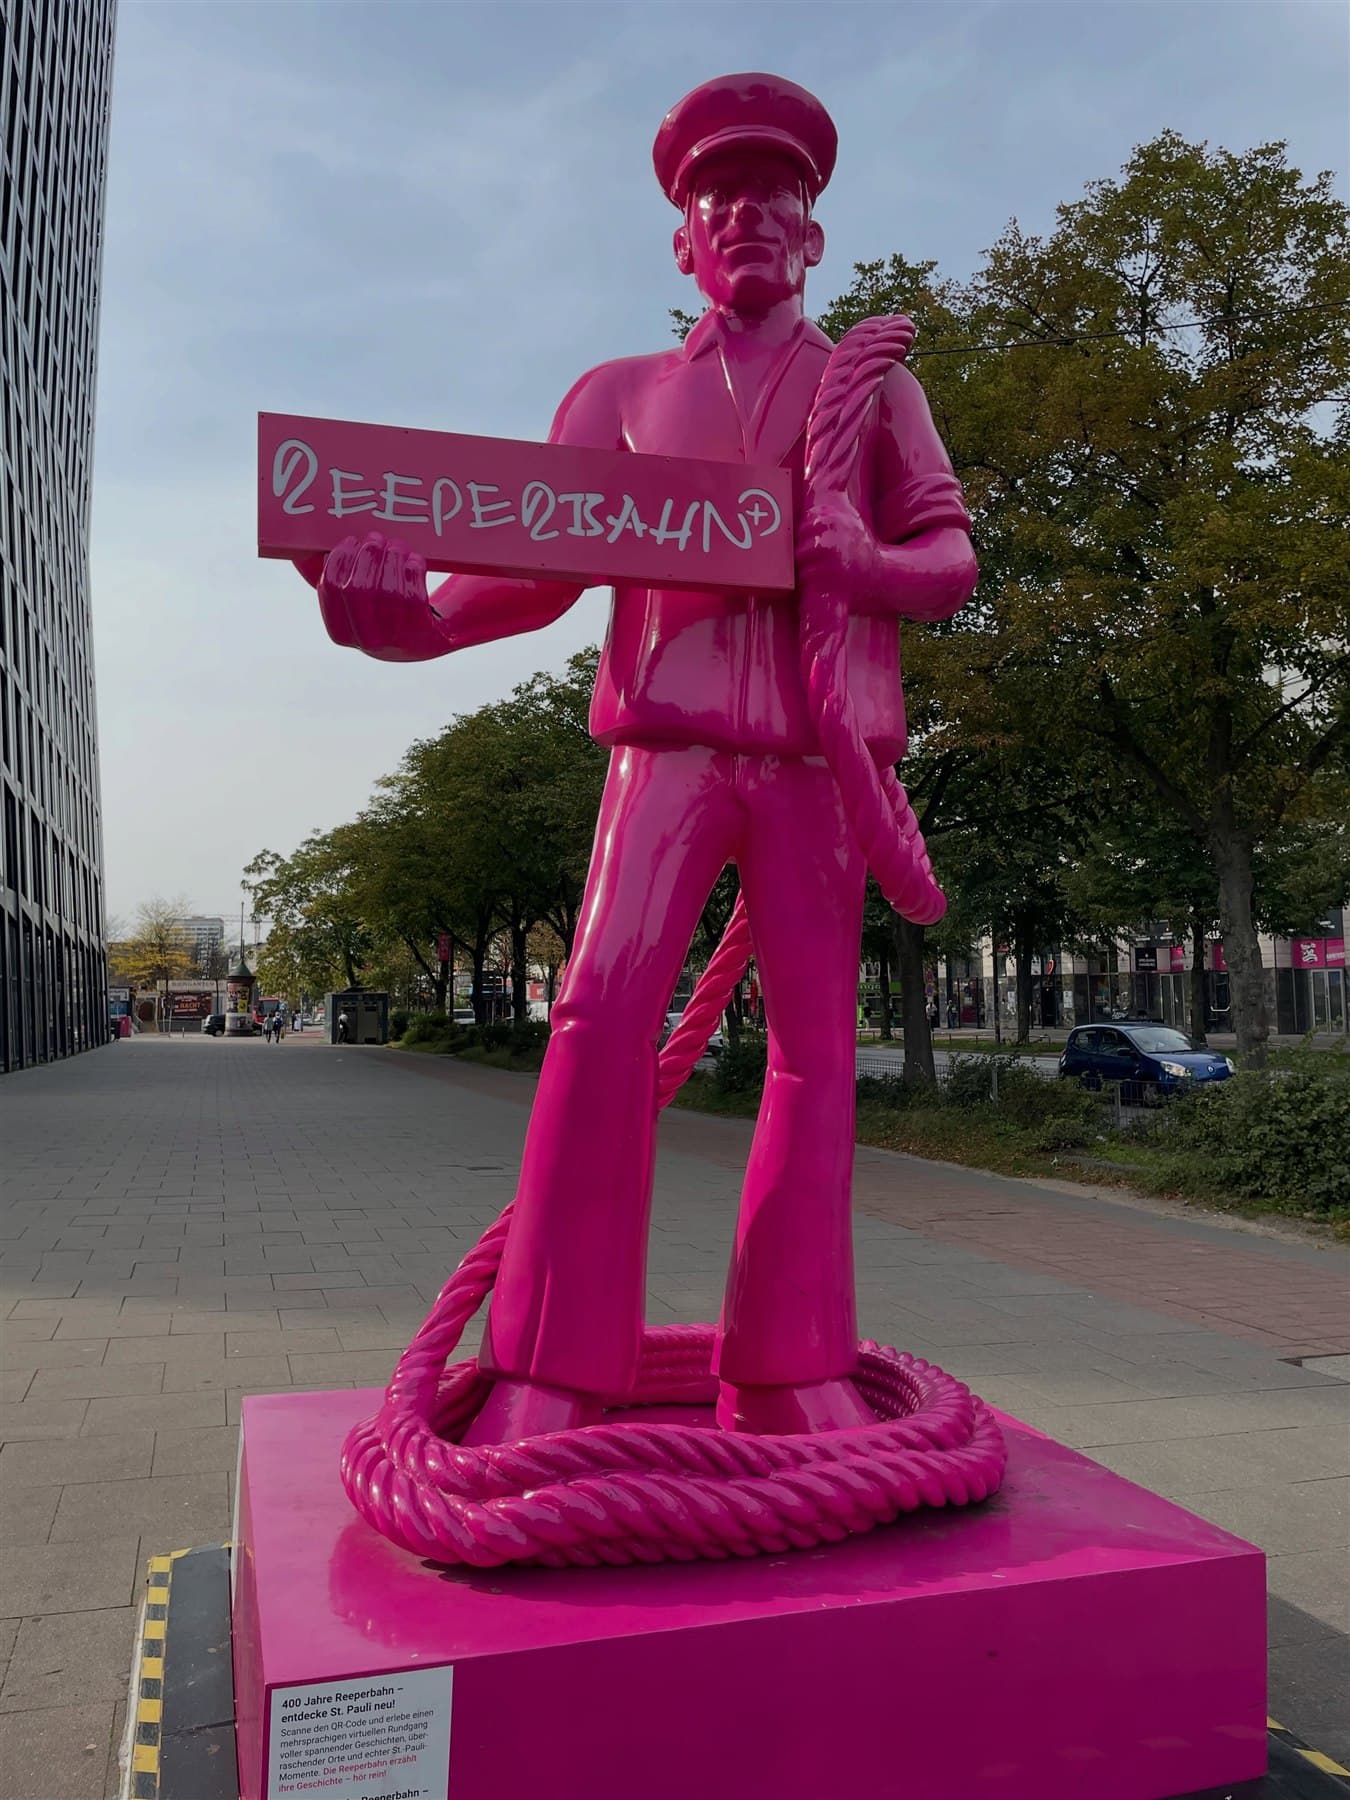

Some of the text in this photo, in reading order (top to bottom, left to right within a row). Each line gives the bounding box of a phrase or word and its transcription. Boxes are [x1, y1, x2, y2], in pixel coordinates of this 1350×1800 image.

[282, 1698, 301, 1709] 400
[304, 1694, 333, 1706] Jahre
[336, 1686, 395, 1702] Reeperbahn
[280, 1709, 434, 1738] Scanne den QR-Code und erlebe einen
[281, 1699, 396, 1723] entdecke St. Pauli neu!
[280, 1721, 429, 1749] mehrsprachigen virtuellen Rundgang
[280, 1749, 302, 1760] voller
[304, 1741, 353, 1757] spannender
[355, 1734, 407, 1750] Geschichten,
[279, 1758, 326, 1771] raschender
[328, 1754, 346, 1764] Orte
[347, 1752, 363, 1761] und
[364, 1748, 391, 1759] echter
[279, 1754, 417, 1782] Momente. Die Reeperbahn erzählt
[278, 1783, 295, 1793] ihre
[296, 1777, 343, 1790] Geschichte
[353, 1772, 366, 1782] hör
[368, 1769, 387, 1780] rein!
